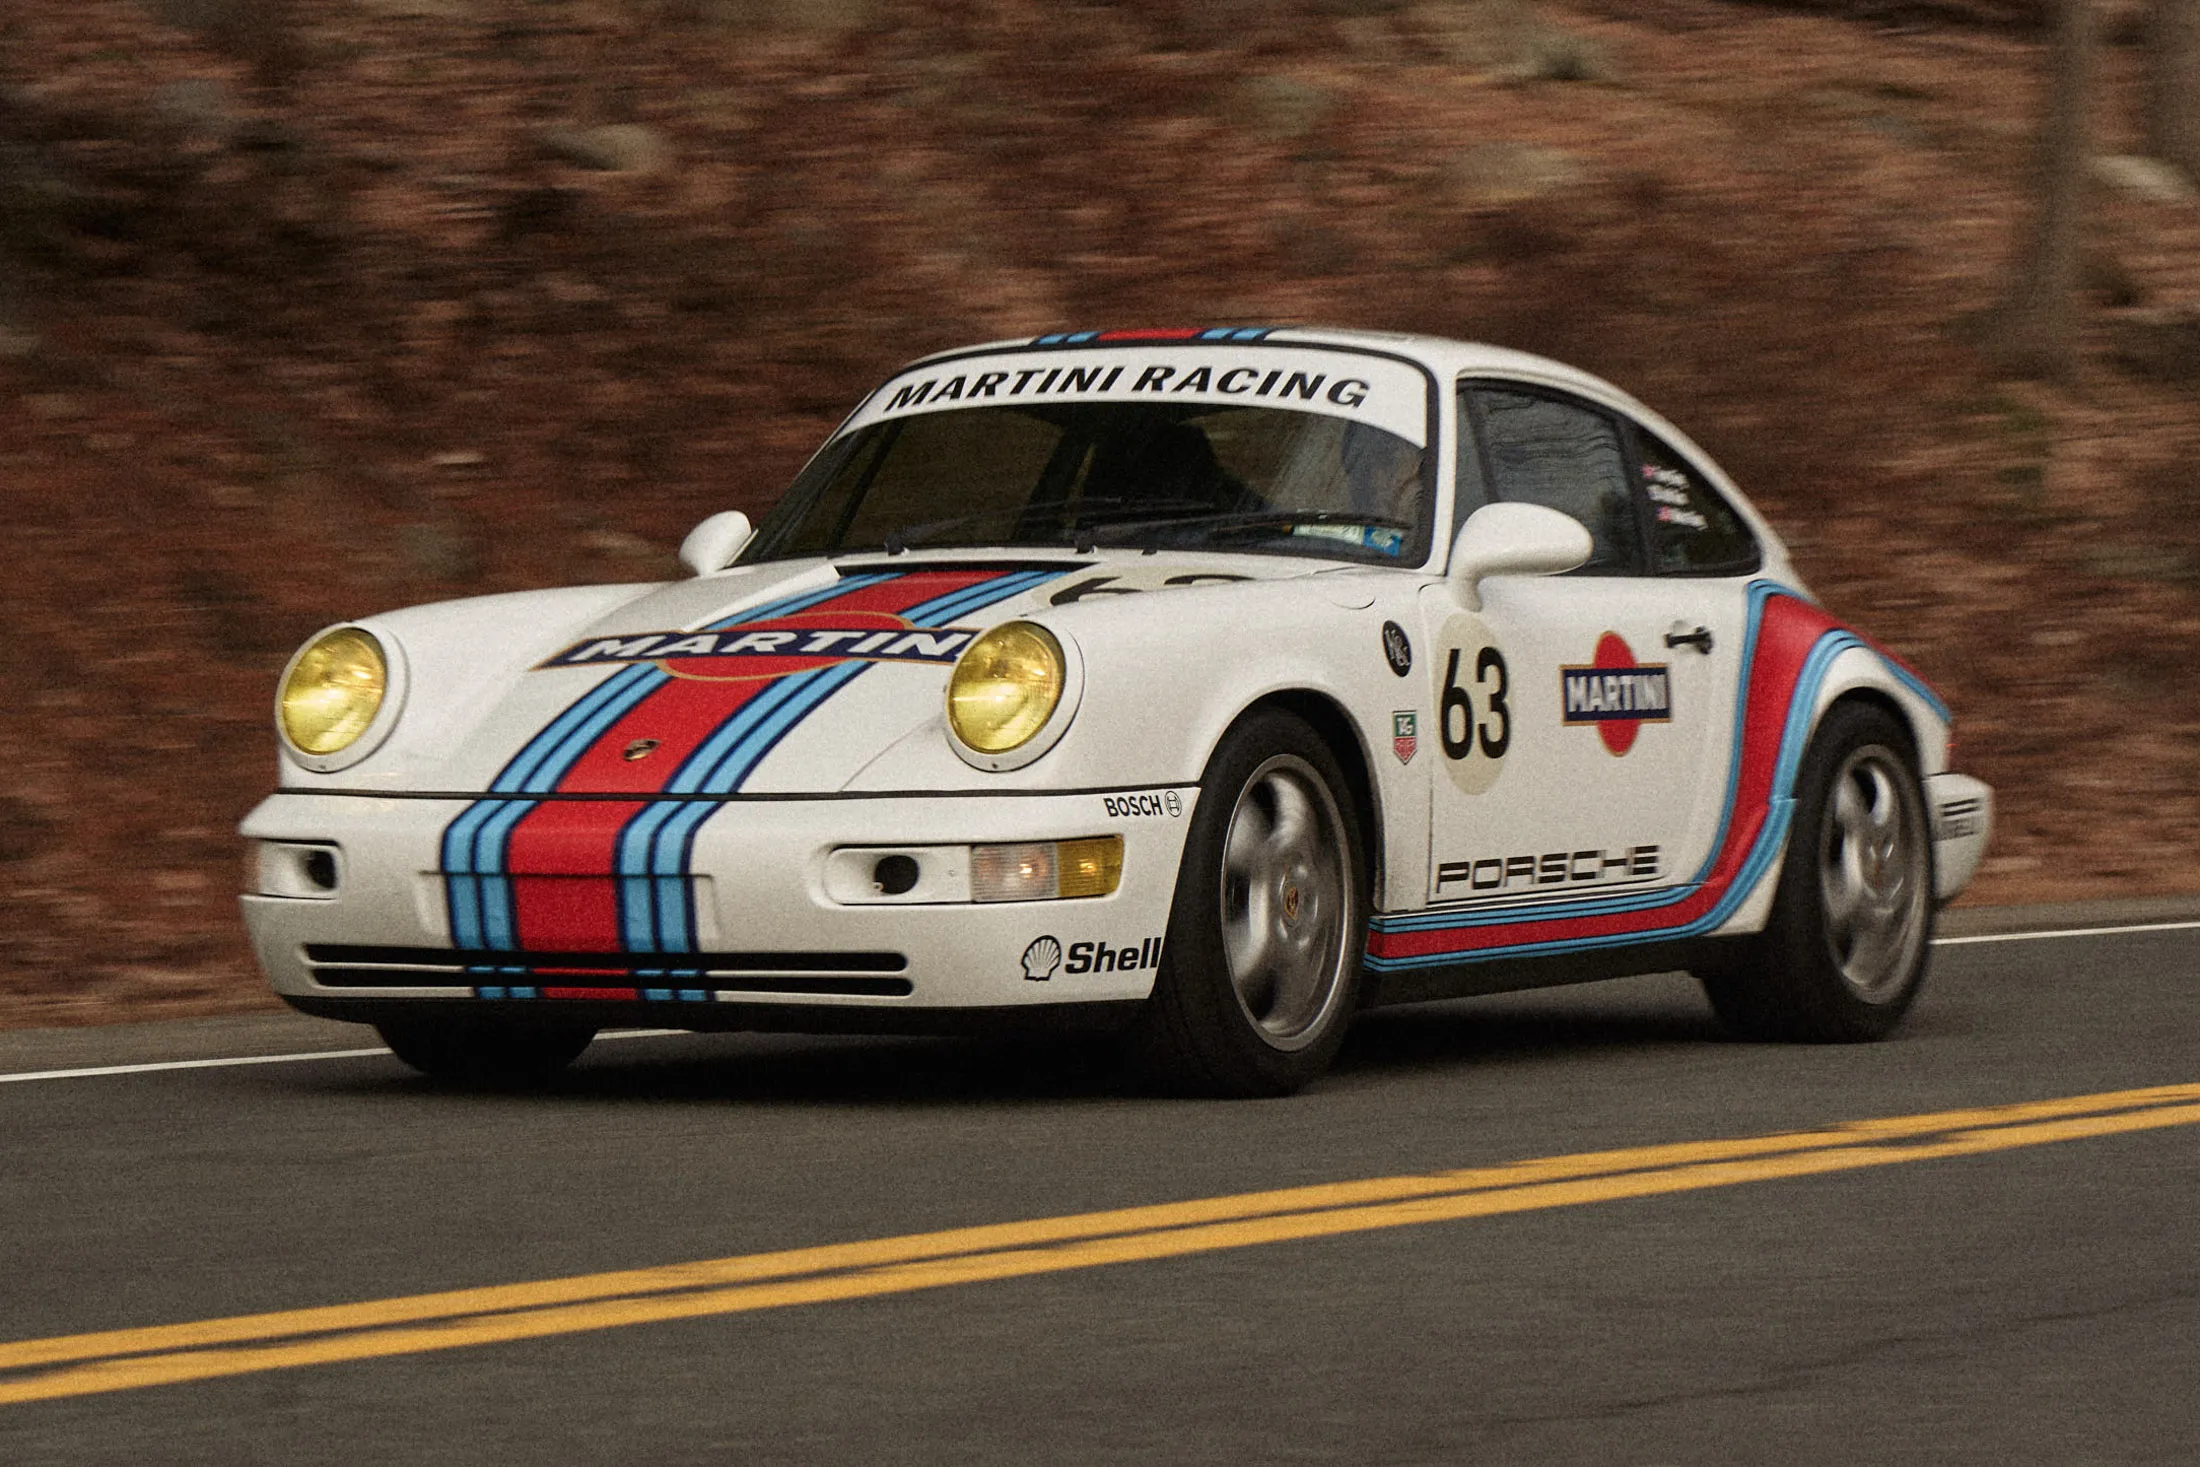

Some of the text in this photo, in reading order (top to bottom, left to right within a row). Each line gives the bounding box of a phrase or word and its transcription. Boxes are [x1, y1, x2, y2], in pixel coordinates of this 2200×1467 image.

[885, 366, 1370, 411] MARTINI RACING
[569, 631, 972, 661] MARTIN
[1441, 647, 1511, 760] 63
[1566, 674, 1667, 712] MARTINI
[1104, 795, 1163, 816] BOSCH
[1436, 846, 1660, 893] PORSCHE
[1065, 937, 1162, 974] Shell
